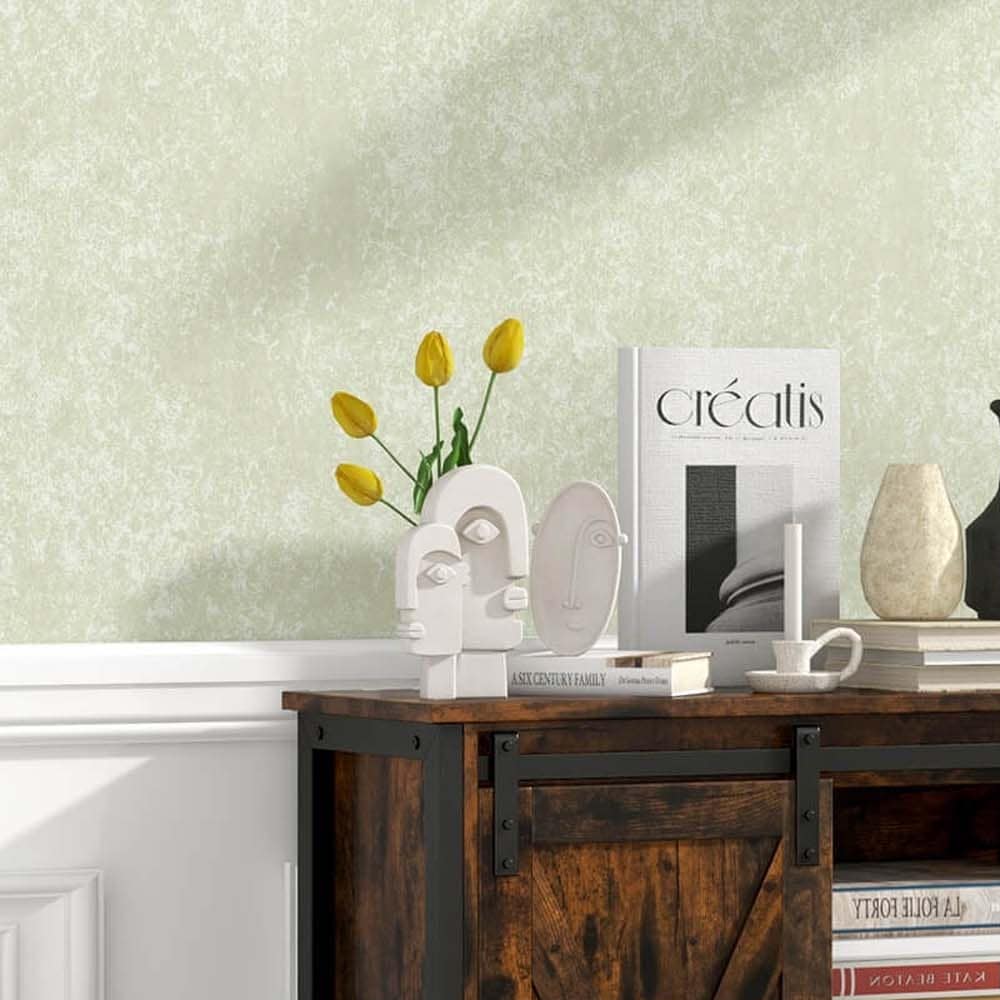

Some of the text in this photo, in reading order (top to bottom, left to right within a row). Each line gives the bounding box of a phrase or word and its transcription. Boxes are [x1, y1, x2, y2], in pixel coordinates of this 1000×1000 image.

[656, 377, 825, 429] créatis
[533, 672, 574, 687] CENTURY
[574, 672, 607, 688] FAMILY
